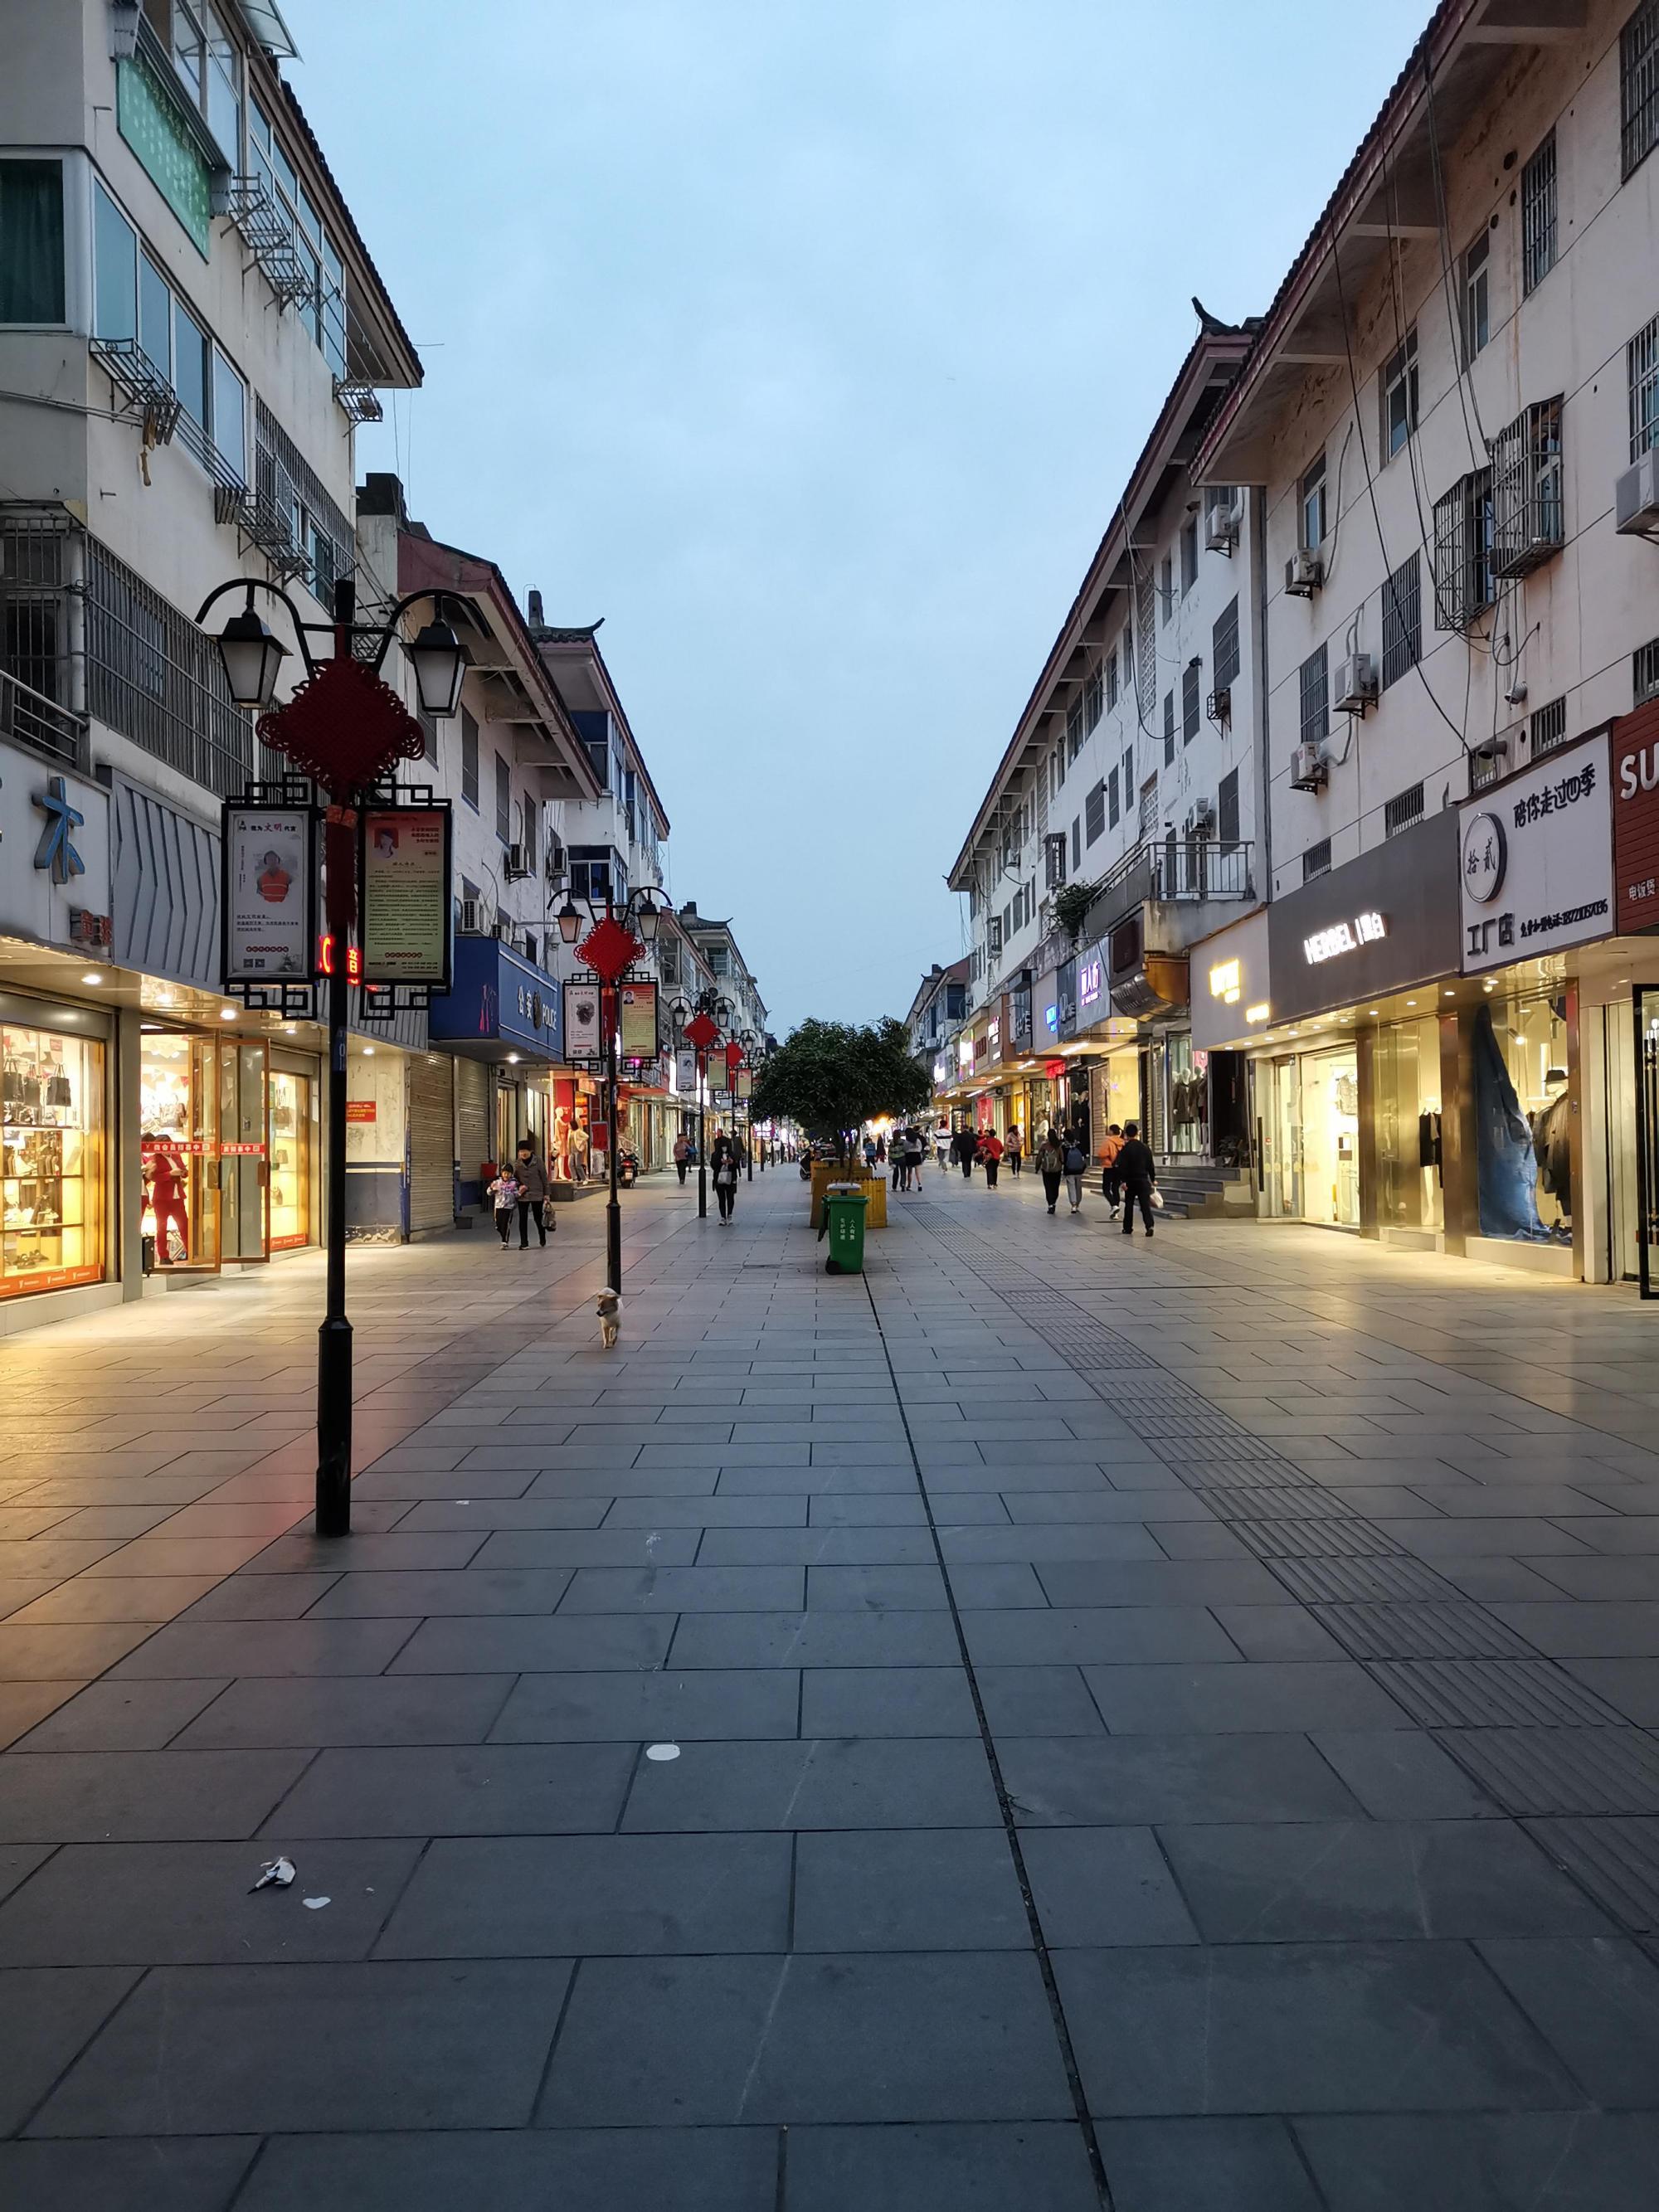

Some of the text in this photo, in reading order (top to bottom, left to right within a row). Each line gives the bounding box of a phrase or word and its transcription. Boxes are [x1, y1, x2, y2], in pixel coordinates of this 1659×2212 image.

[1513, 763, 1596, 829] 陪你走过四季
[1467, 836, 1496, 874] 拾贰
[1467, 912, 1515, 956] 工厂店
